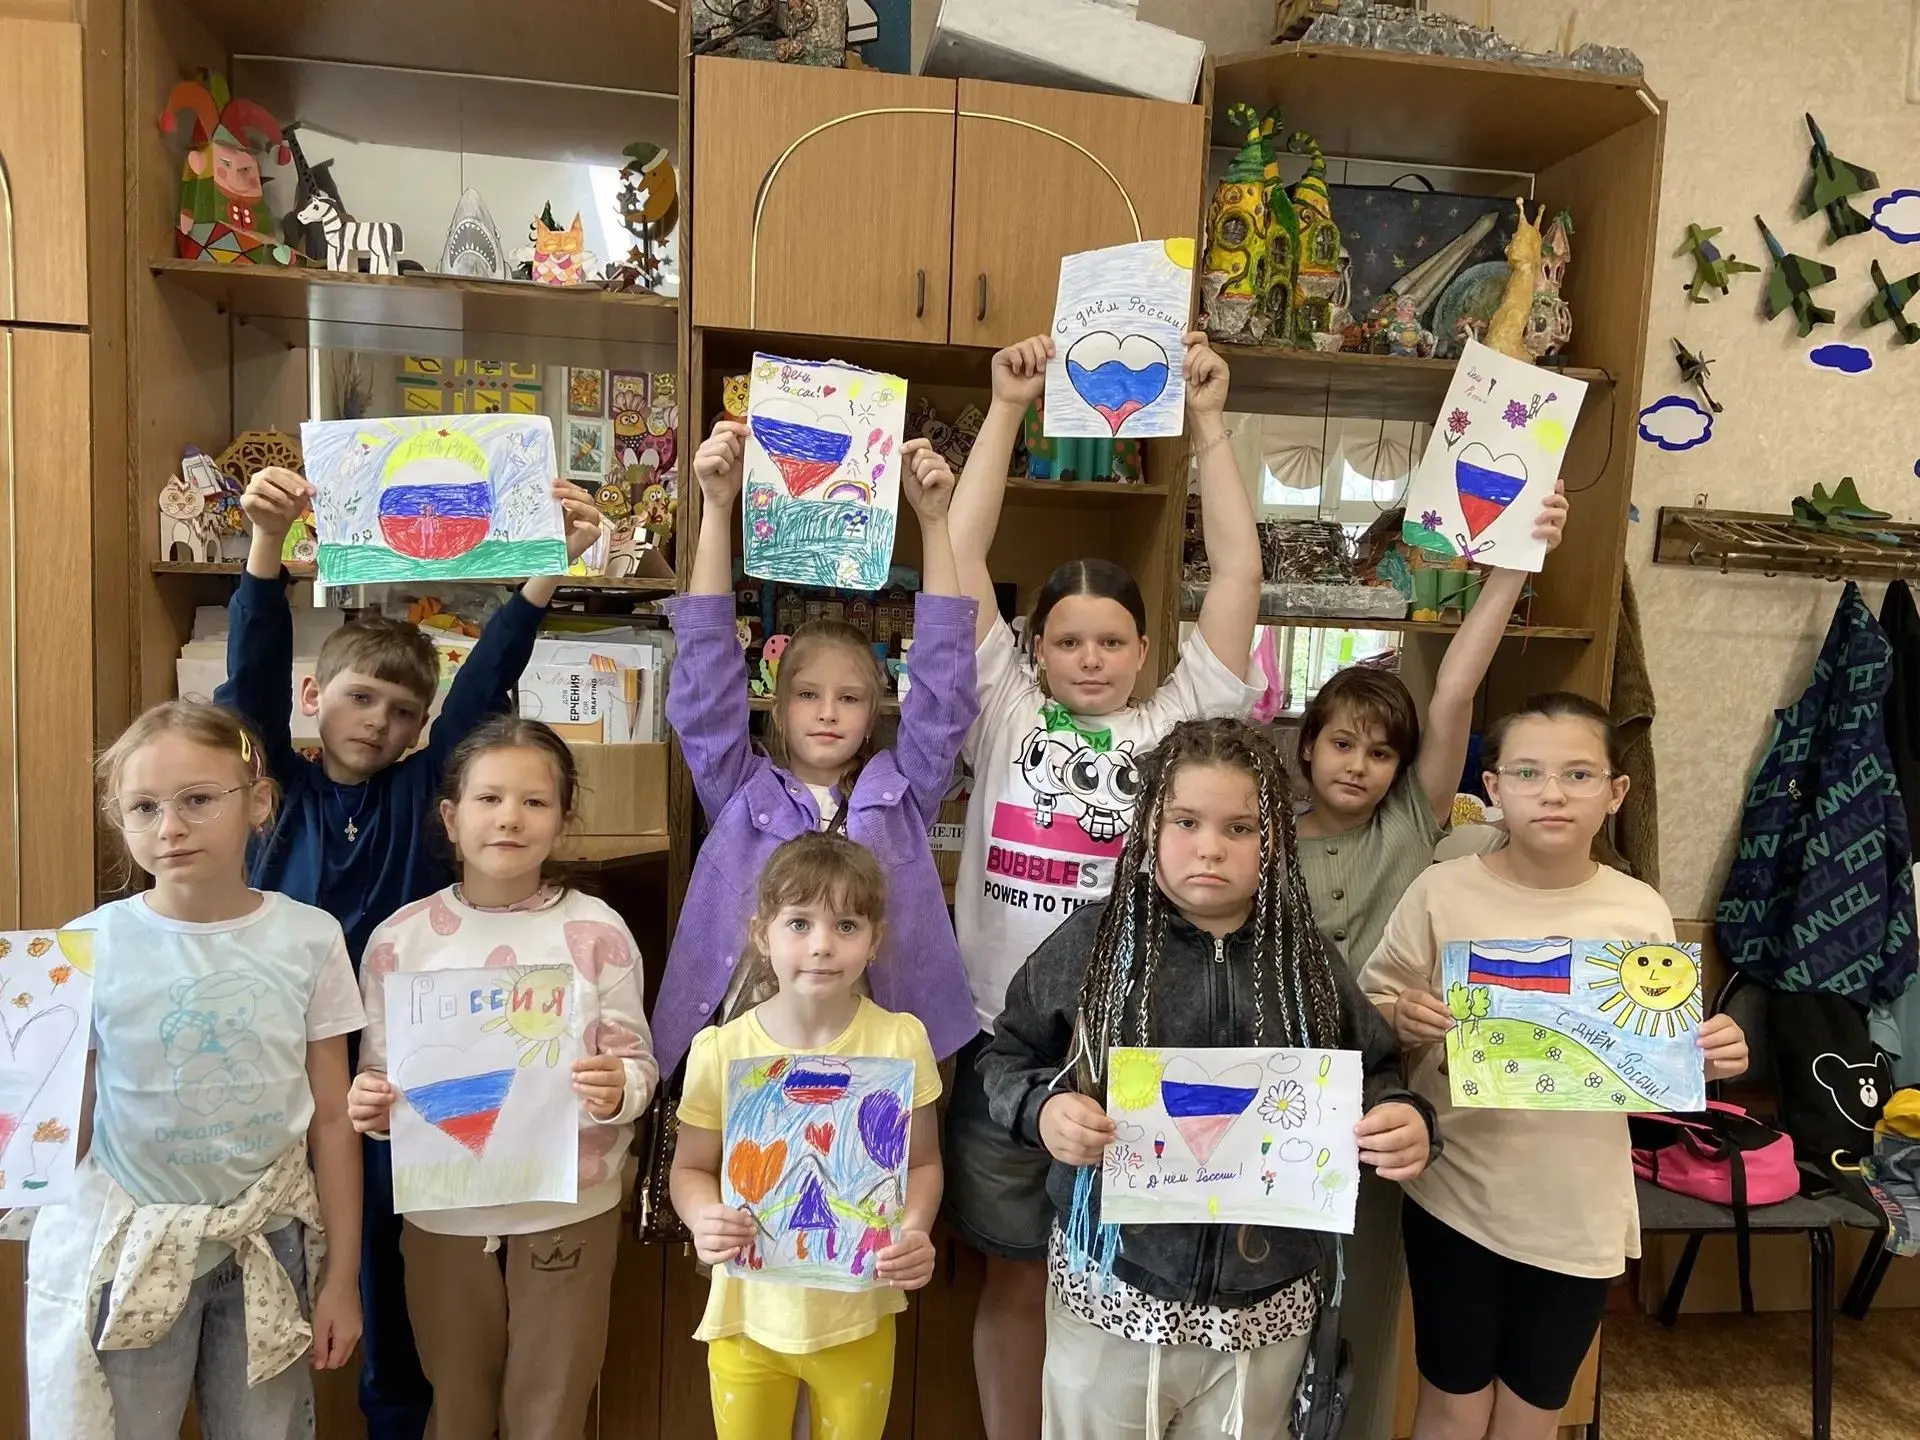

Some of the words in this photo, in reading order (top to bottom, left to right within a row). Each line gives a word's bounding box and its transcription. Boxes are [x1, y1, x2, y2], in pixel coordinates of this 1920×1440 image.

[1127, 296, 1187, 331] России!
[986, 844, 1098, 890] BUBBLES
[984, 881, 1029, 909] POWER
[1033, 893, 1056, 913] TO
[1061, 897, 1093, 915] TH
[1617, 1052, 1670, 1099] России!
[155, 1120, 235, 1143] Dreams
[246, 1111, 284, 1127] Are
[166, 1133, 273, 1166] Achievable
